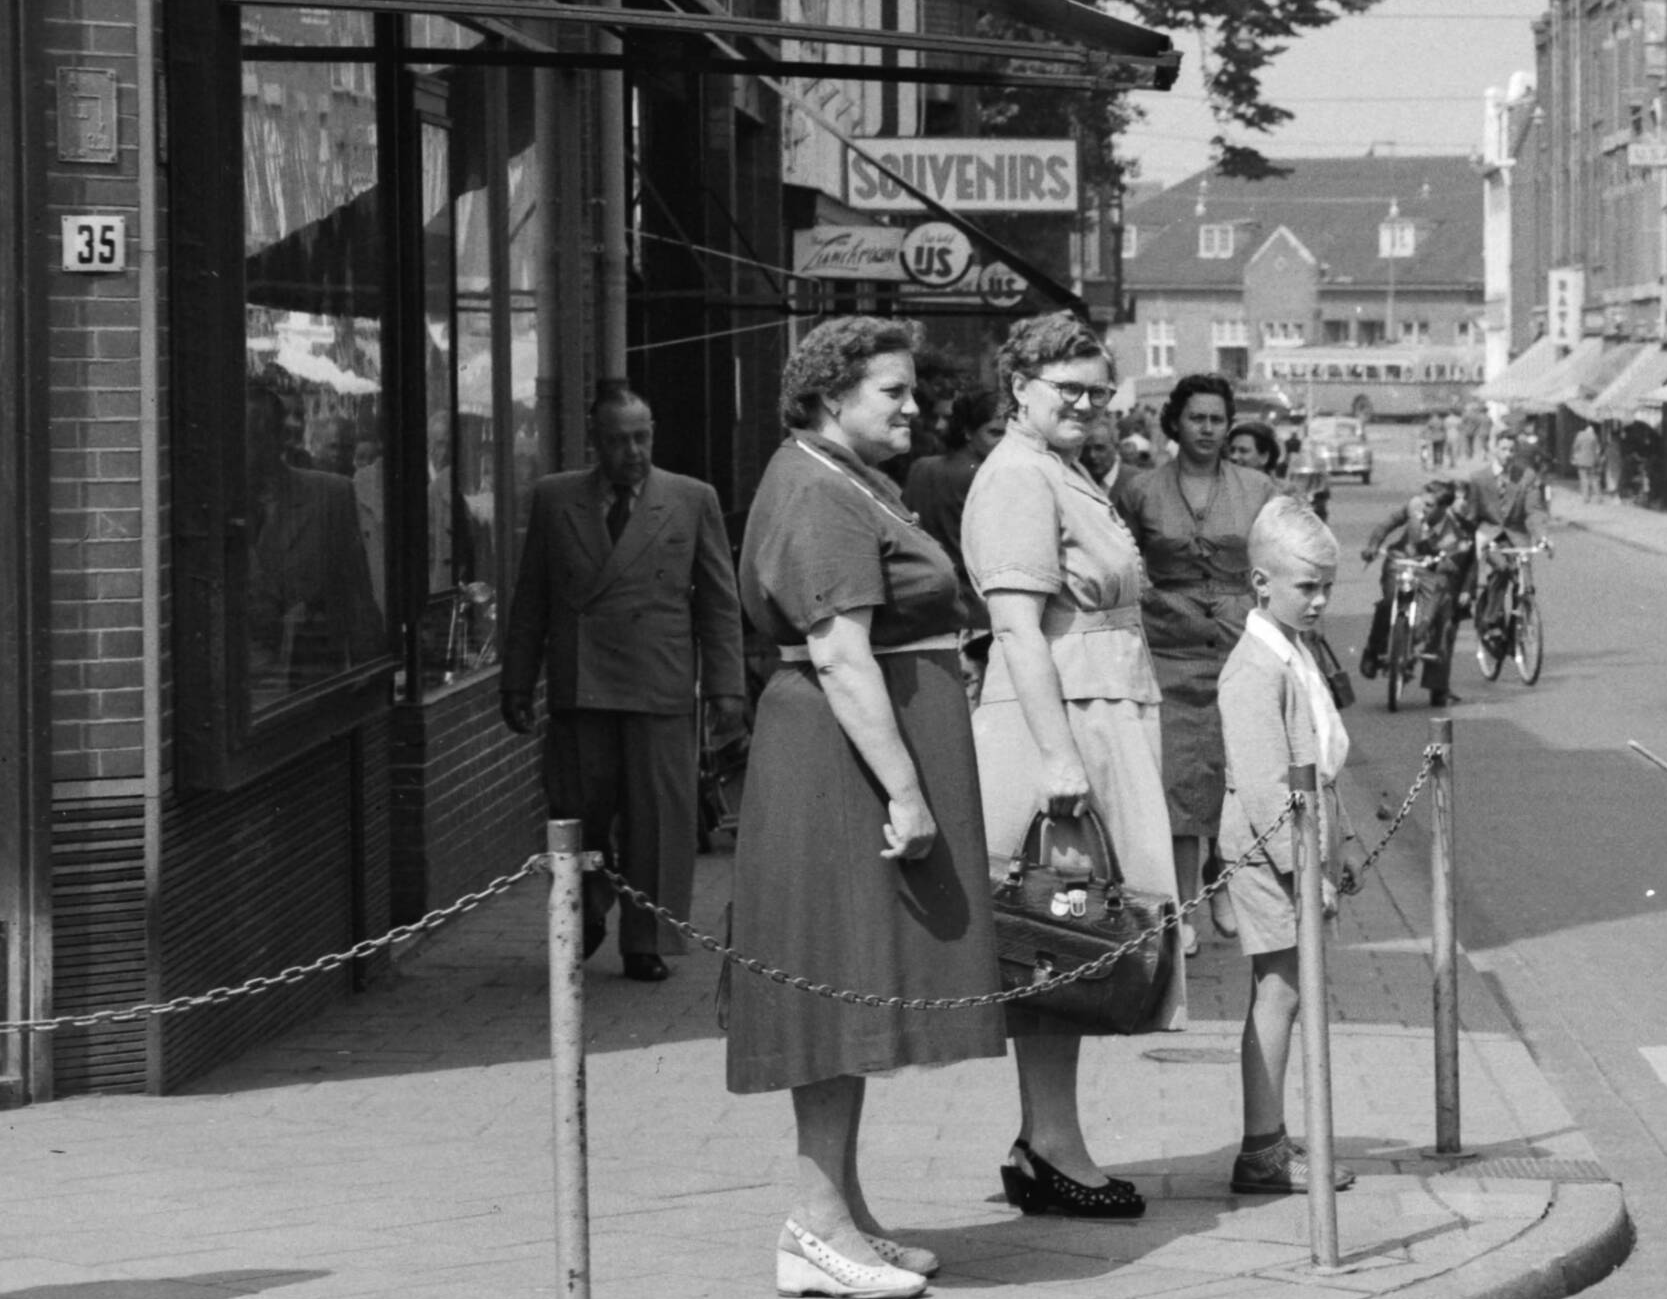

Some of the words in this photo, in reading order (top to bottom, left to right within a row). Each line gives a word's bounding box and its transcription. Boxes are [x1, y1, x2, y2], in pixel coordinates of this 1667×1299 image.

[853, 153, 1073, 203] SOUVENIRS
[77, 225, 115, 264] 35
[914, 245, 952, 278] IJS
[1556, 278, 1568, 339] BATA
